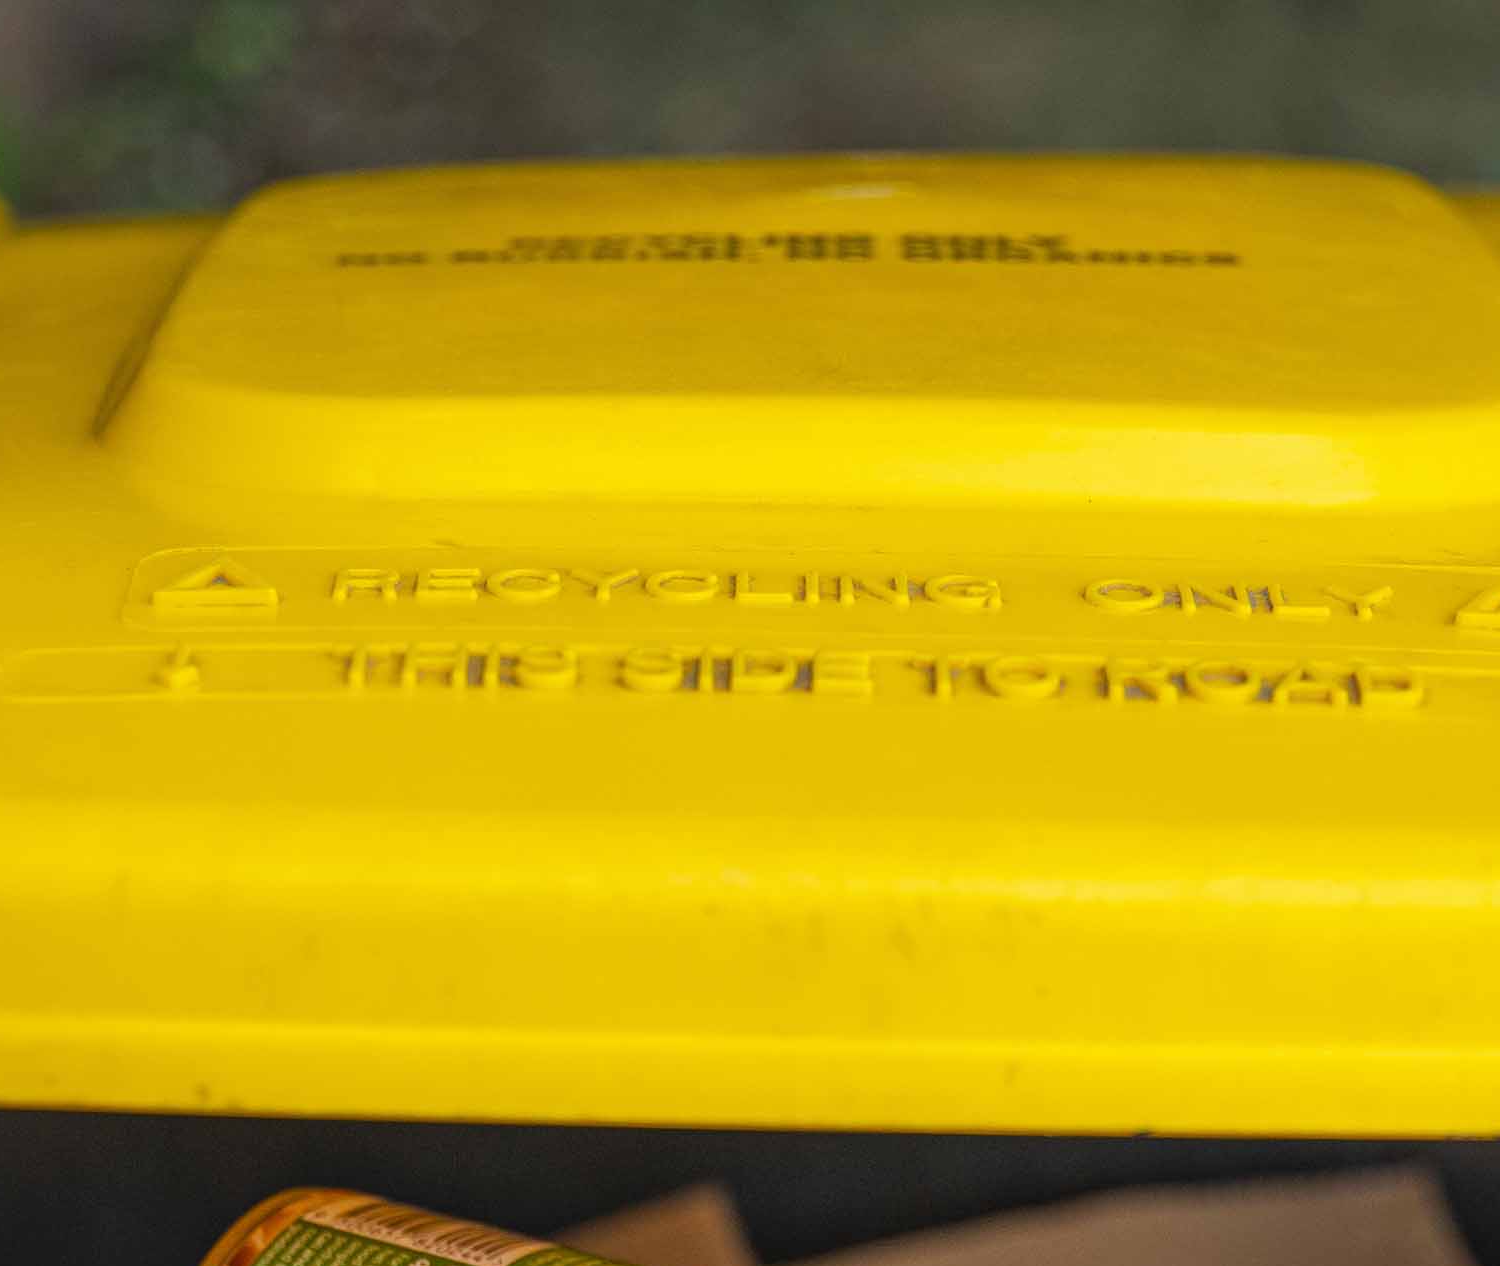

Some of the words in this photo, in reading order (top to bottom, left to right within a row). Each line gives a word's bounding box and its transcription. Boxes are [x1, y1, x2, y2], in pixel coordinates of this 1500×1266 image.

[332, 567, 1002, 609] RECYCLING
[1084, 578, 1394, 620] ONLY
[332, 644, 578, 690] THIS
[620, 645, 875, 694] SIDE
[912, 653, 1062, 701] TO
[1100, 657, 1426, 710] ROAD
